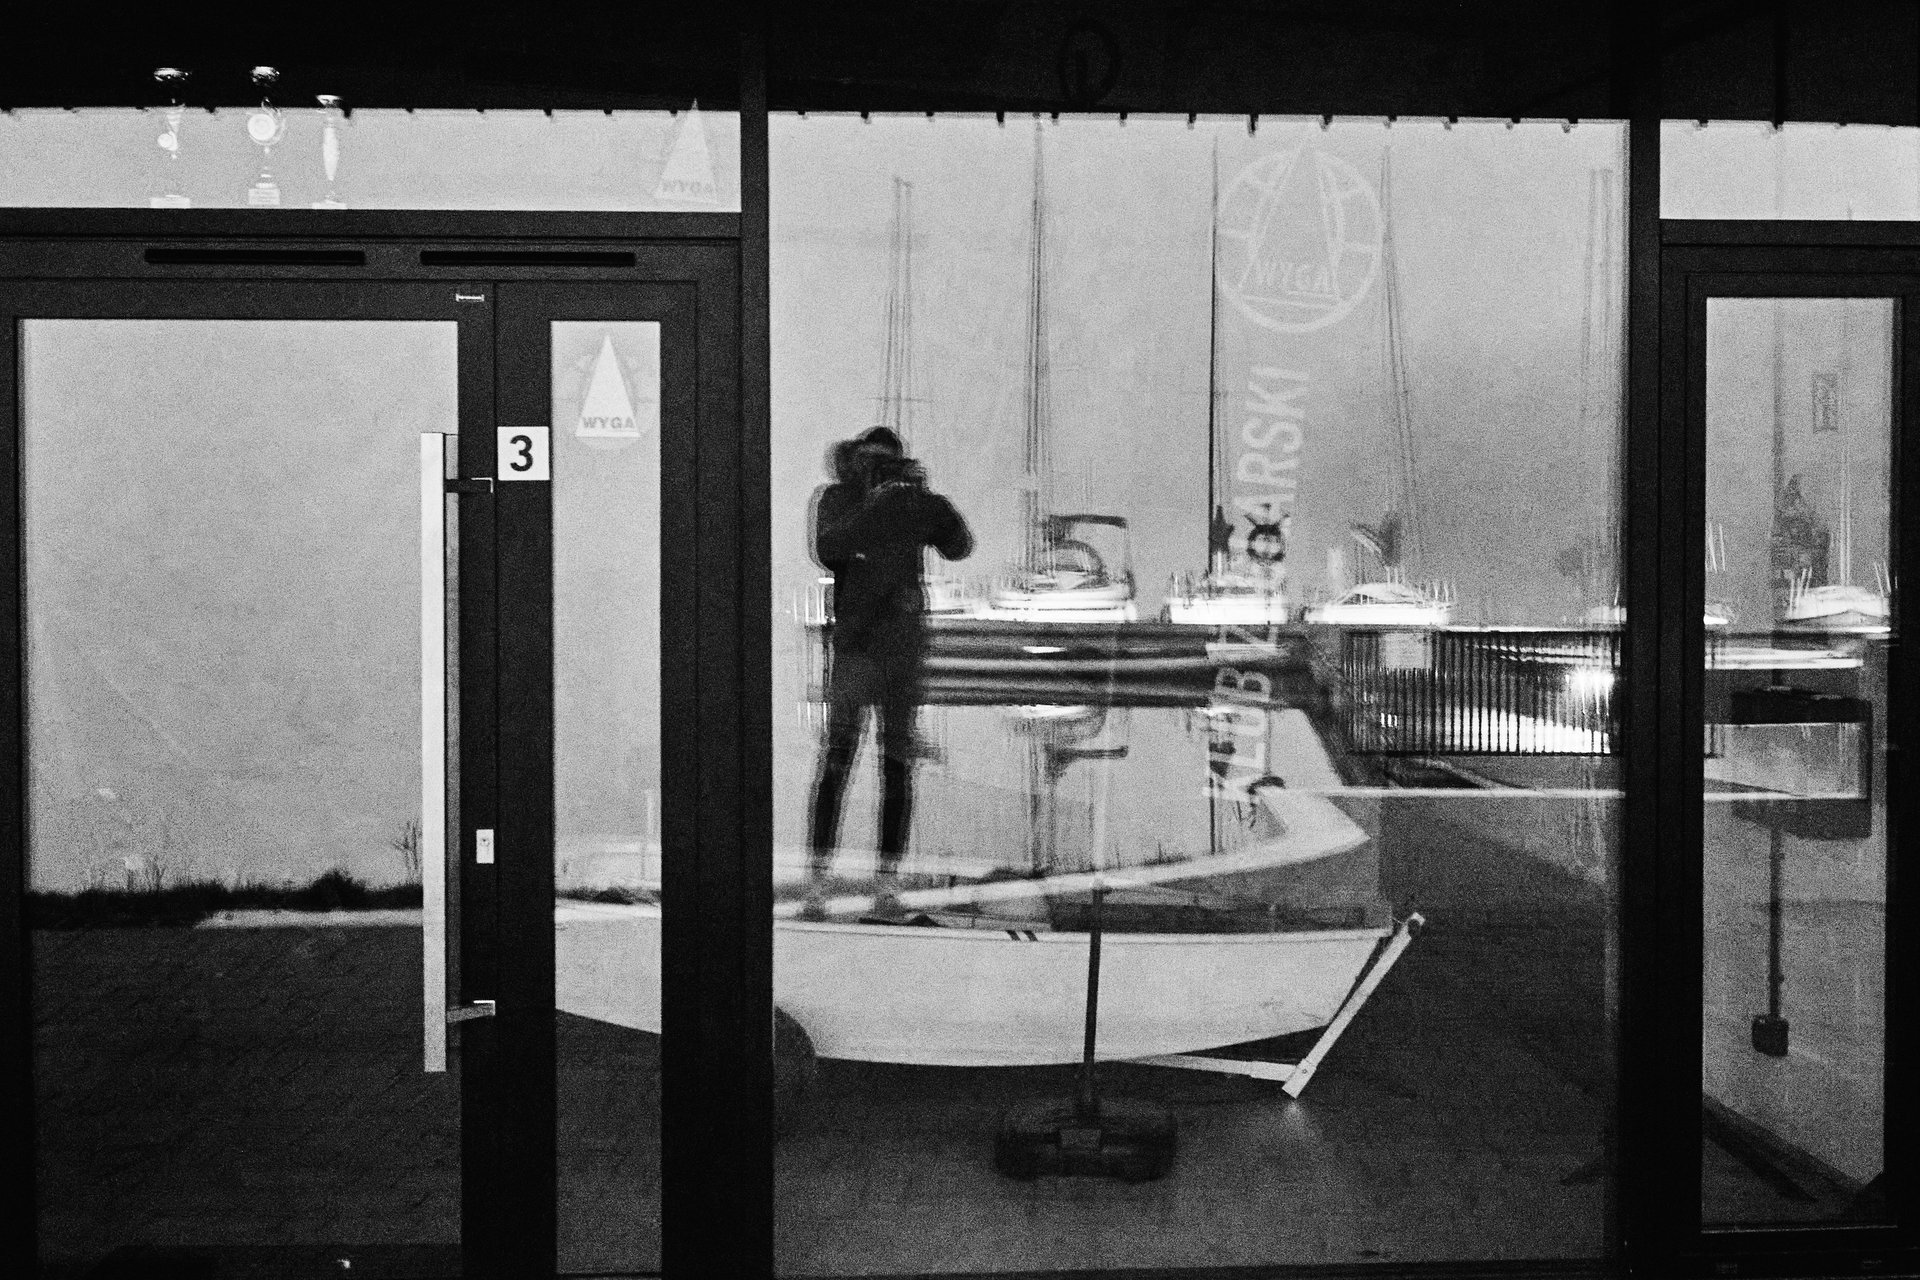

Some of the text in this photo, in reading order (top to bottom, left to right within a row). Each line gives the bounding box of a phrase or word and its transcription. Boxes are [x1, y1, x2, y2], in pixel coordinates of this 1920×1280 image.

[1254, 259, 1331, 292] WYGA
[582, 416, 635, 429] WYGA
[510, 434, 534, 472] 3
